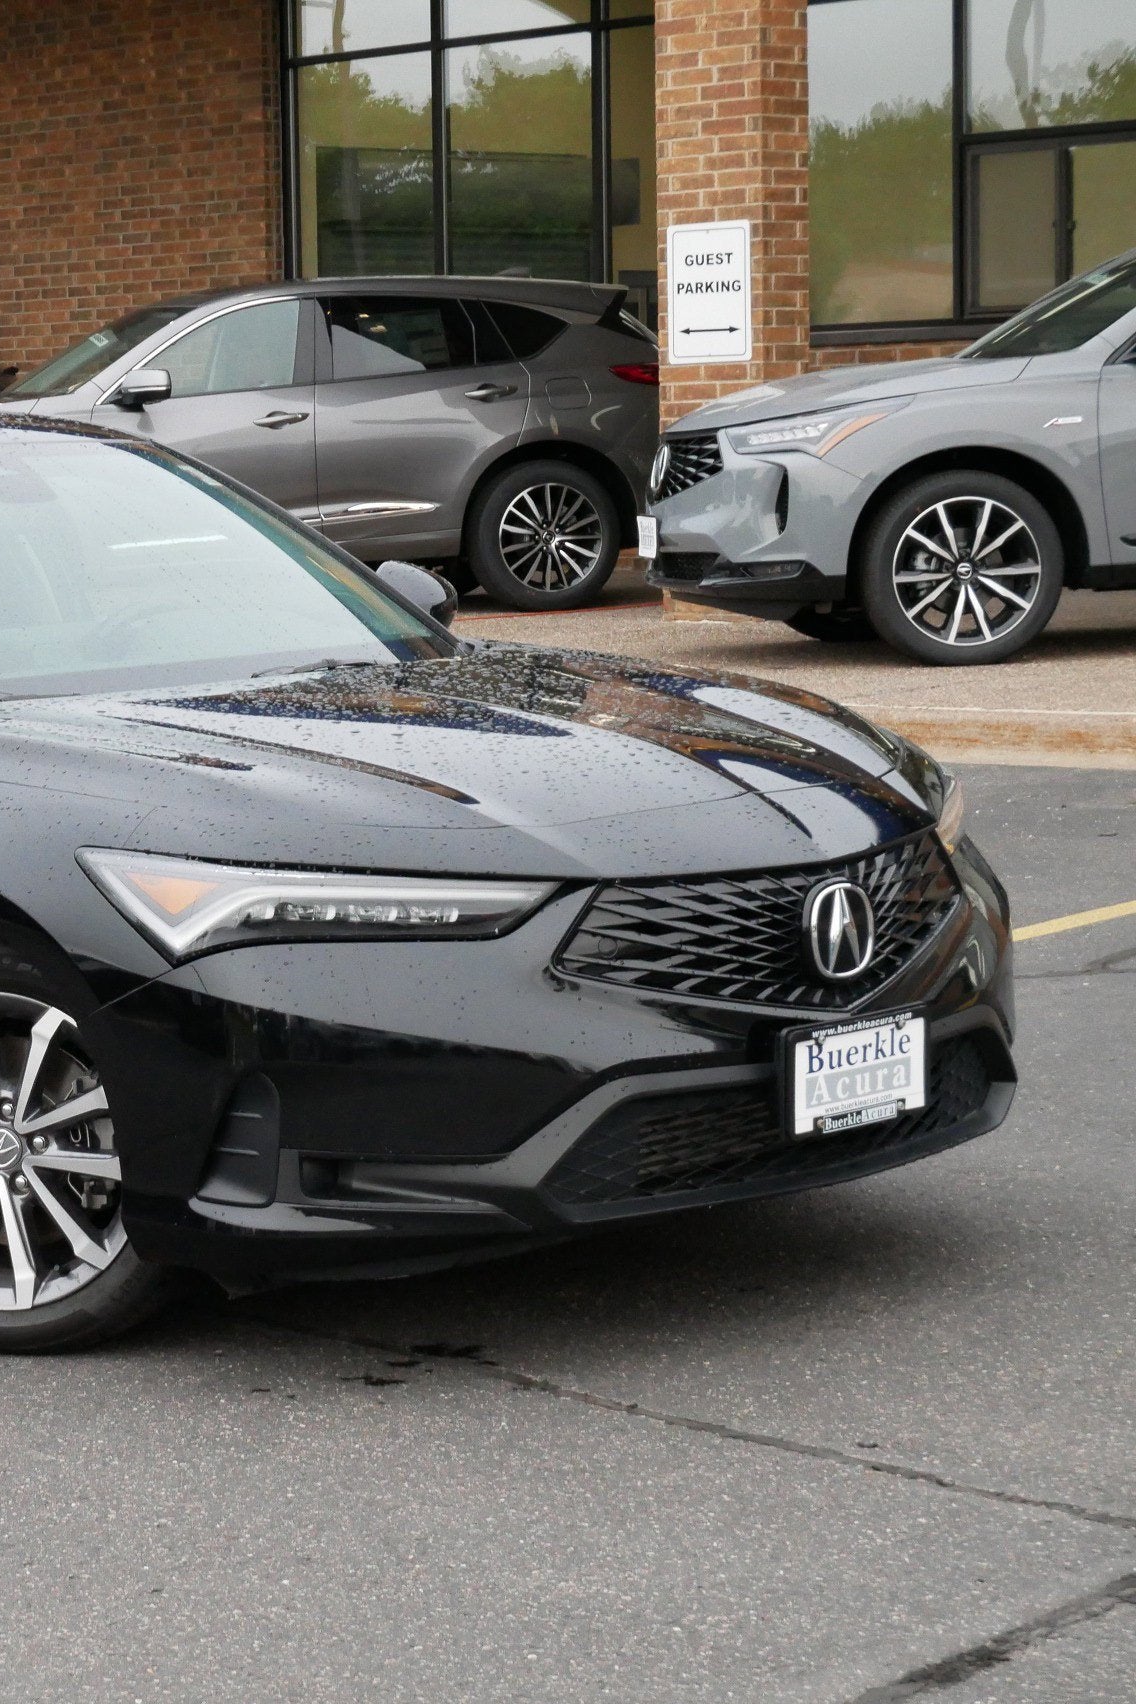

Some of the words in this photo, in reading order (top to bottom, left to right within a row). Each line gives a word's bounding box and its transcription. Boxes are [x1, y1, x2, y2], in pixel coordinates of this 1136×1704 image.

[684, 252, 733, 267] GUEST
[676, 280, 741, 295] PARKING
[812, 1012, 912, 1038] www.buerkleacura.com
[806, 1028, 911, 1074] Buerkle
[810, 1064, 907, 1105] Acura
